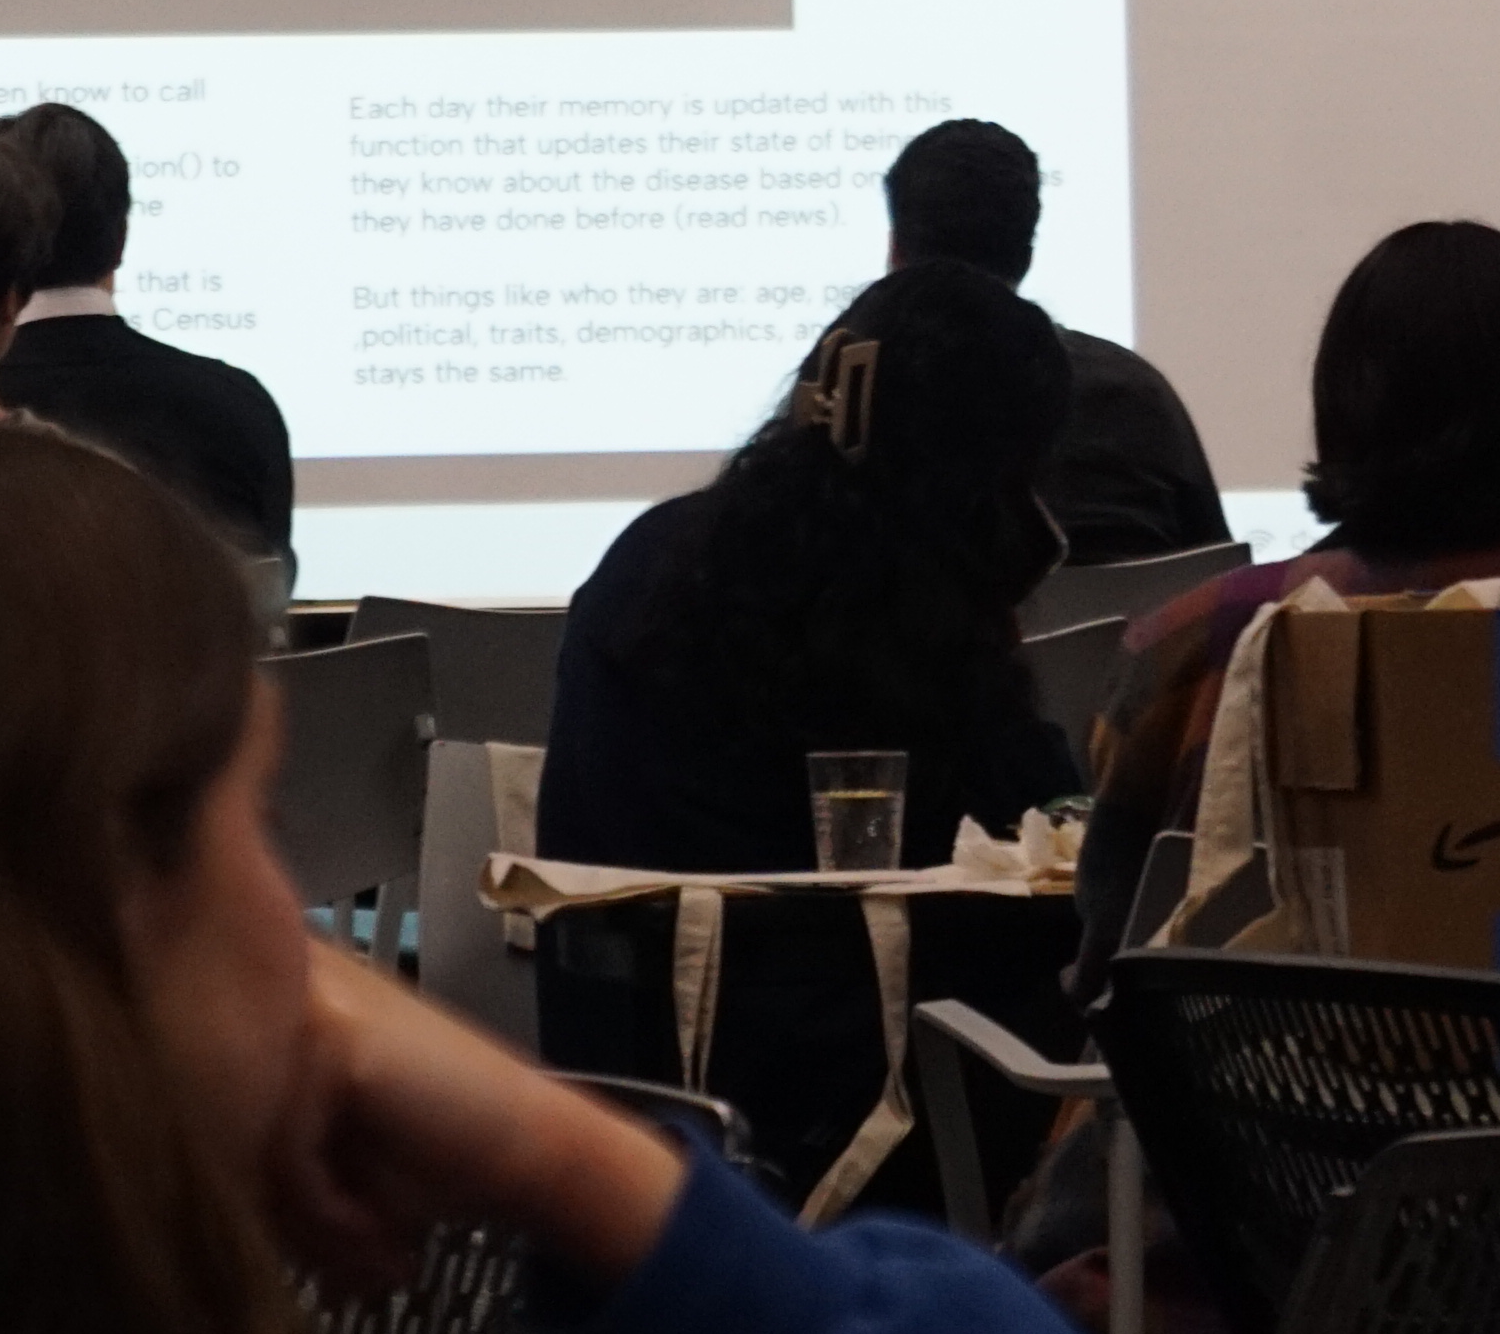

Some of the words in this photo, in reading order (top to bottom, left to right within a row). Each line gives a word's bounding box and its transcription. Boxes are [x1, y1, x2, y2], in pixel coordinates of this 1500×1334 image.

[37, 81, 112, 105] know
[121, 82, 150, 104] to
[159, 78, 206, 104] call
[349, 95, 418, 120] Each
[427, 95, 476, 121] day
[485, 94, 550, 117] their
[558, 98, 674, 120] memory
[683, 93, 705, 116] is
[713, 91, 829, 120] updated
[839, 91, 895, 115] with
[903, 91, 953, 114] this
[349, 133, 464, 158] function
[473, 133, 528, 156] that
[537, 132, 649, 159] updates
[657, 130, 721, 153] their
[730, 131, 799, 154] state
[807, 128, 834, 153] of
[213, 156, 241, 178] to
[349, 172, 411, 198] they
[420, 170, 494, 195] know
[502, 170, 583, 194] about
[591, 169, 637, 193] the
[645, 168, 750, 192] disease
[759, 166, 842, 190] based
[350, 210, 412, 237] they
[421, 208, 486, 233] have
[496, 207, 567, 233] done
[575, 206, 665, 231] before
[675, 203, 748, 231] (read
[757, 201, 847, 228] news).
[136, 269, 191, 294] that
[201, 269, 224, 293] is
[352, 285, 400, 310] But
[409, 284, 495, 313] things
[504, 282, 551, 307] like
[560, 283, 618, 307] who
[627, 281, 688, 307] they
[152, 307, 258, 332] Census
[488, 322, 567, 347] traits,
[576, 319, 784, 350] demographics,
[354, 363, 425, 390] stays
[434, 361, 479, 384] the
[488, 360, 567, 384] same.
